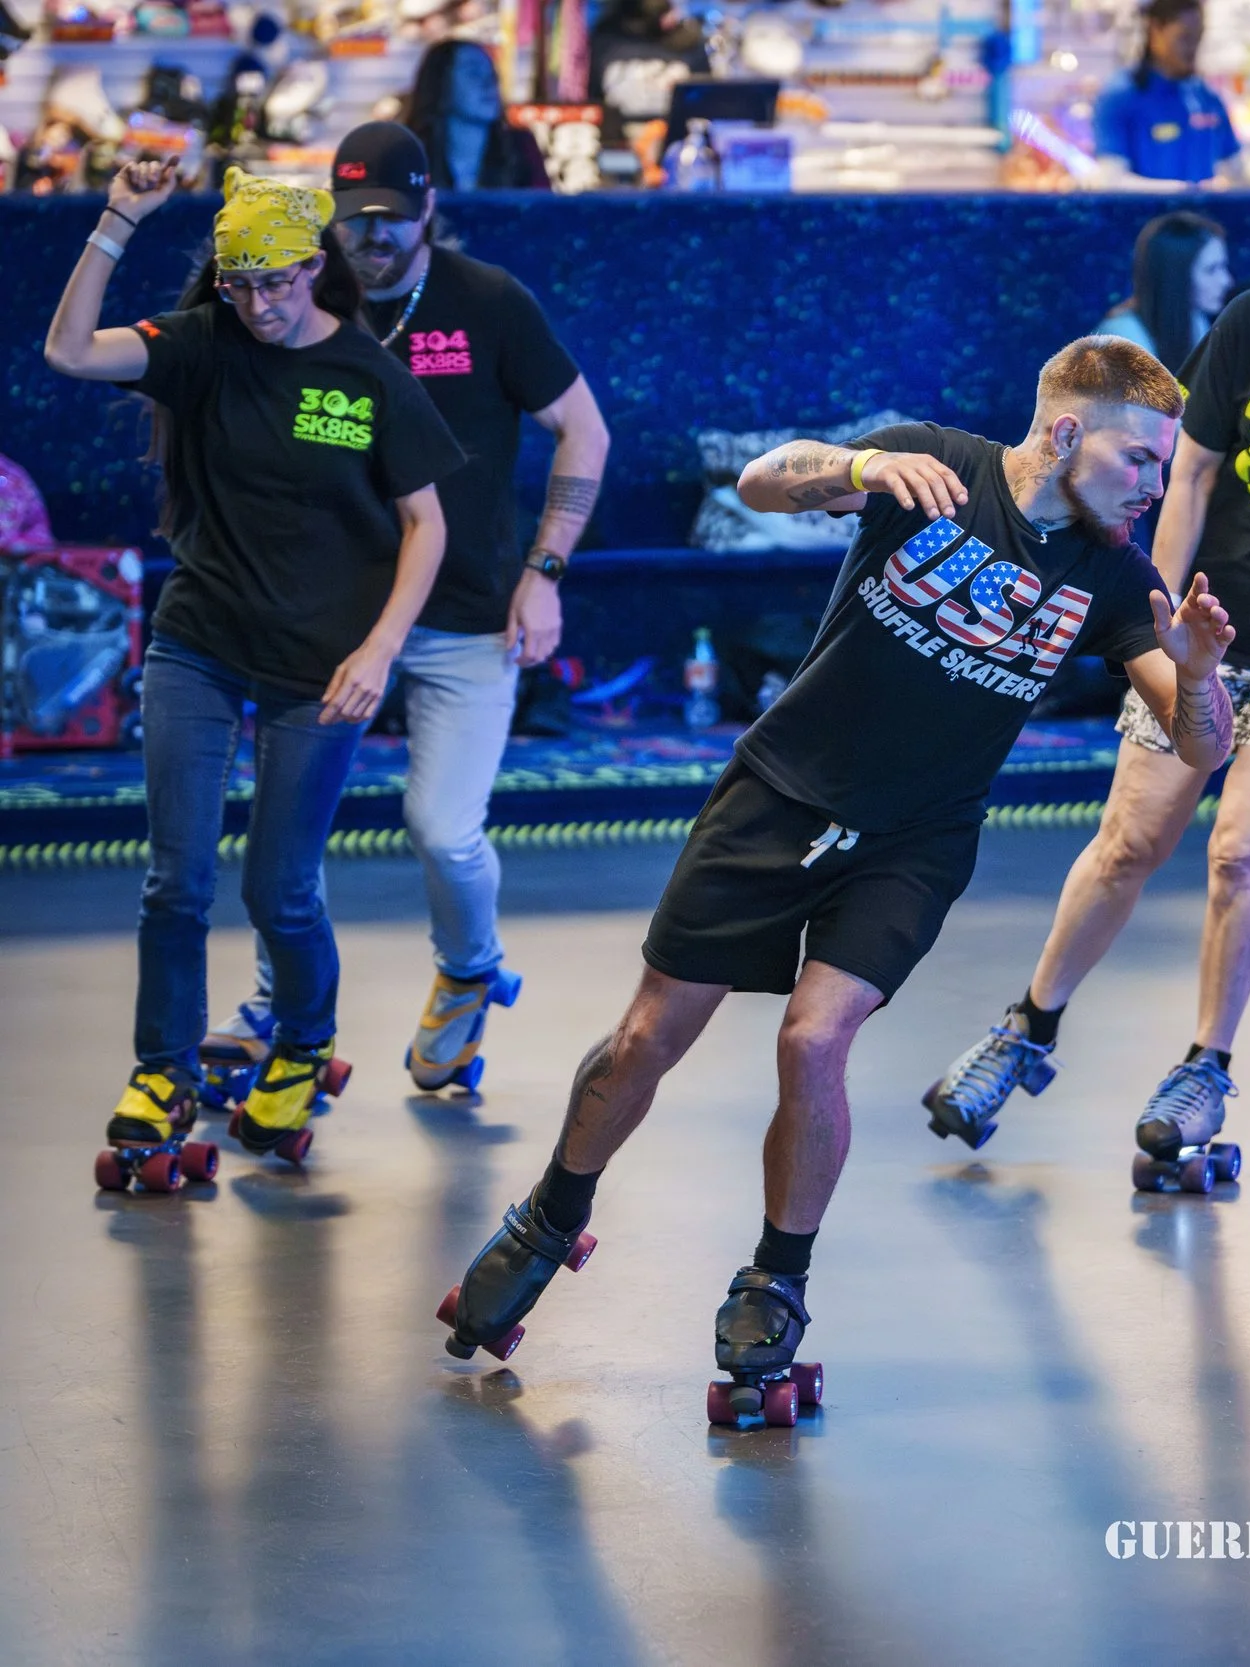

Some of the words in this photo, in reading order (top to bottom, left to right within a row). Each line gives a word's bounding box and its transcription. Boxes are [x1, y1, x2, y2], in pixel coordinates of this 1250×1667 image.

[409, 329, 469, 353] 304
[299, 387, 374, 421] 304
[292, 413, 373, 445] SK8RS
[883, 515, 1094, 677] USA
[857, 576, 949, 659] SHUFFLE
[939, 648, 1047, 703] SKATERS
